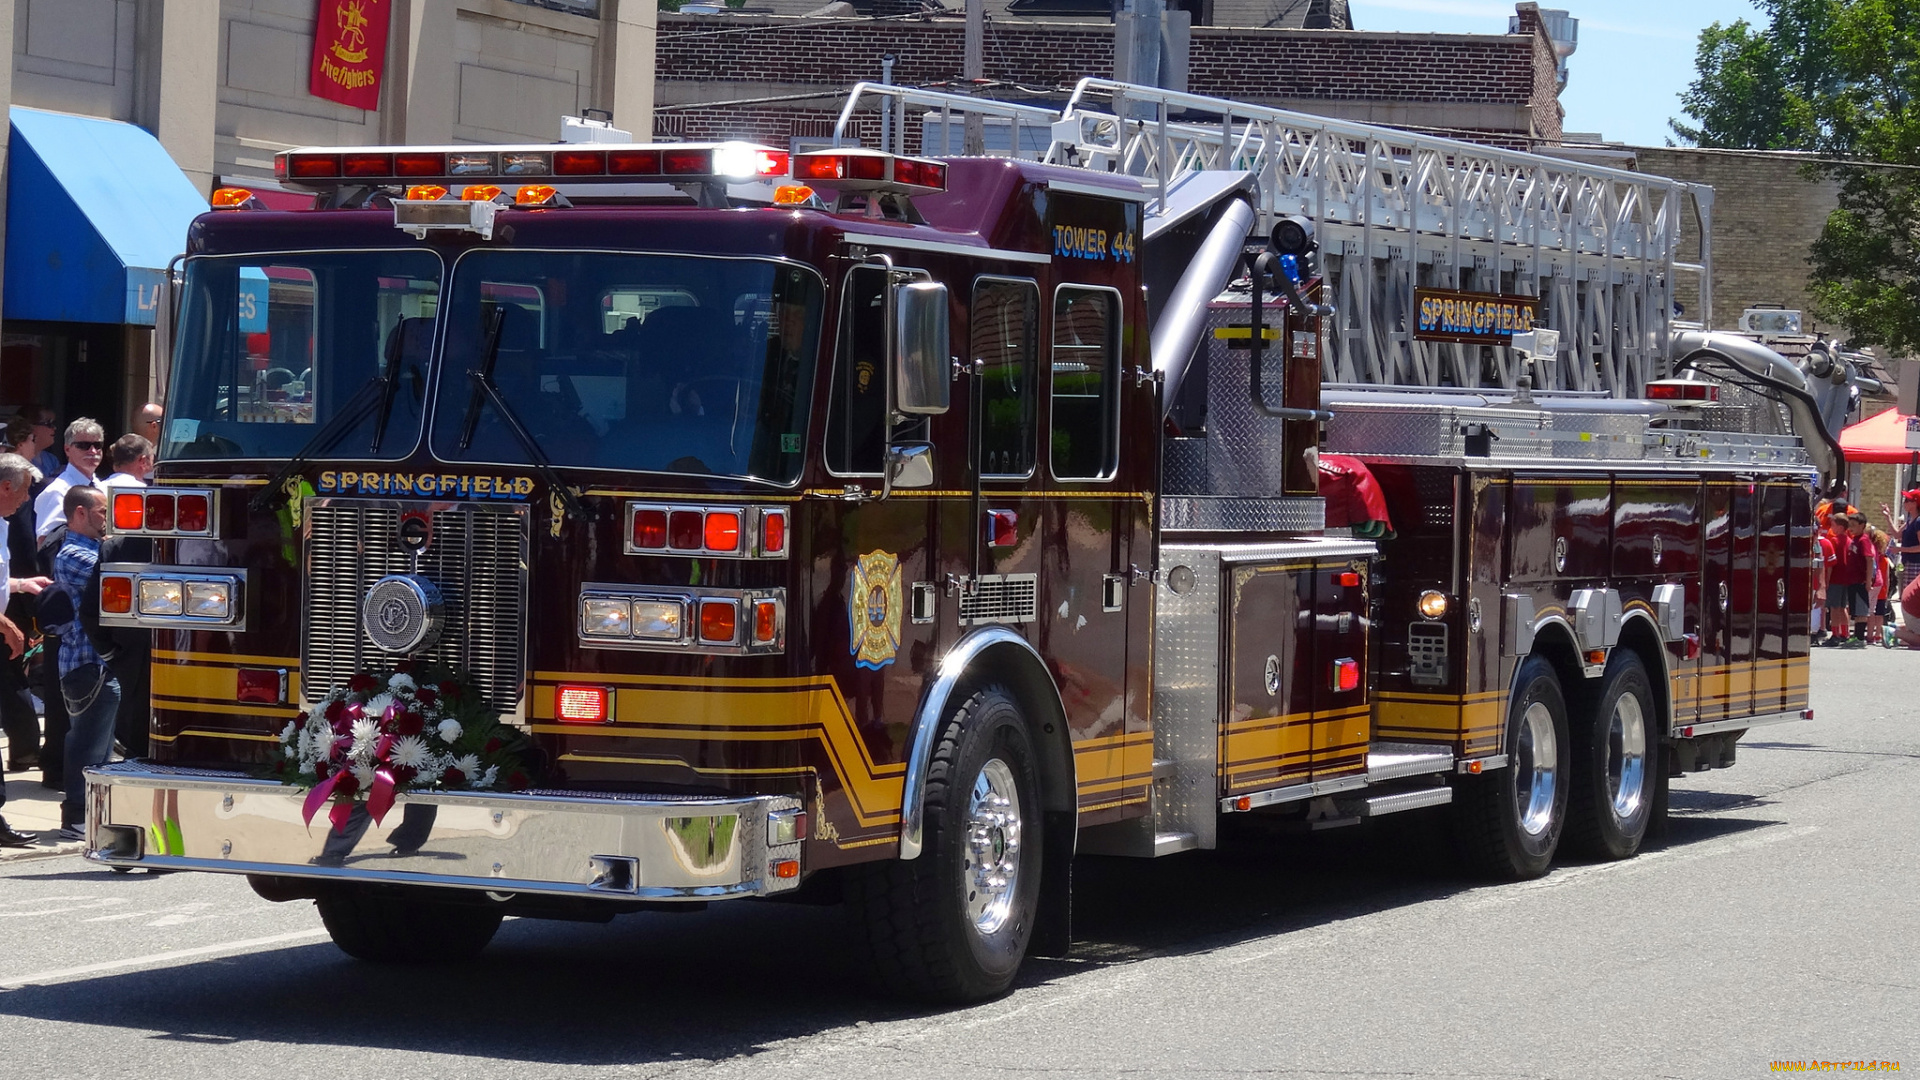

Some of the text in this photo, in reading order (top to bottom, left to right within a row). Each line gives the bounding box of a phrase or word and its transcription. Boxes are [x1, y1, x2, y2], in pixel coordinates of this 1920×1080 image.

[320, 54, 375, 90] Firefighters
[1053, 225, 1136, 263] TOWER 44
[1419, 297, 1535, 335] SPRINGFIELD
[319, 470, 535, 499] SPRINGFIELD
[868, 590, 886, 620] 44
